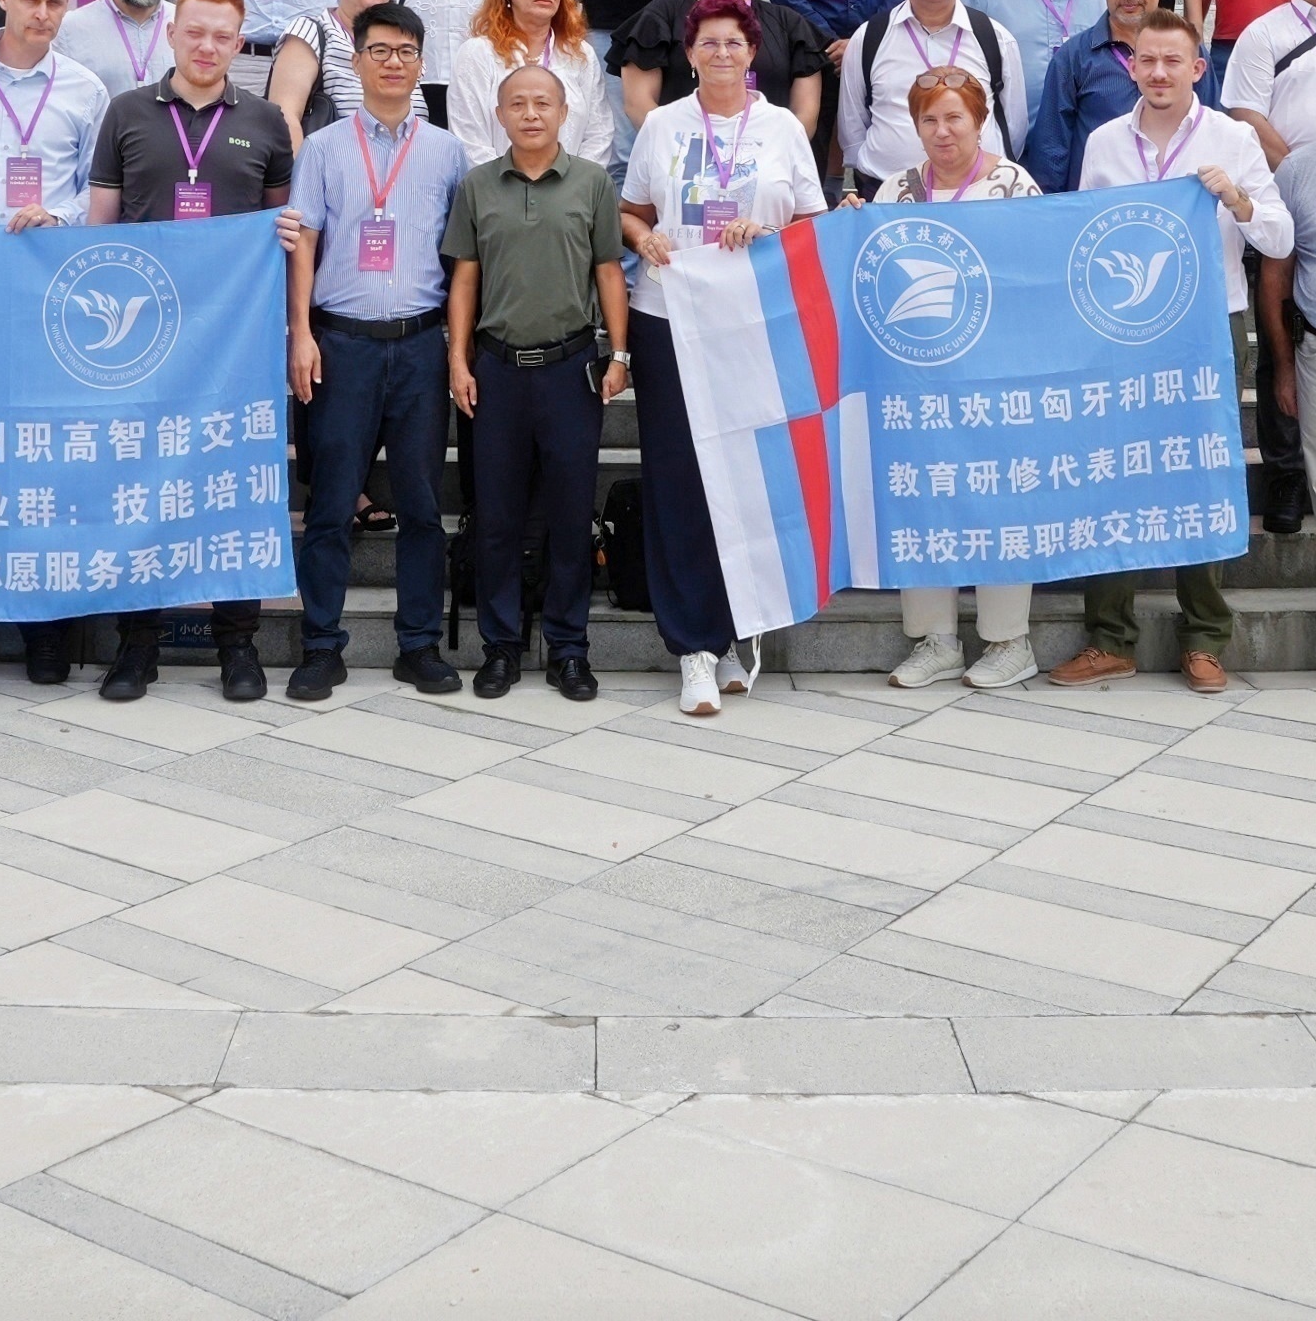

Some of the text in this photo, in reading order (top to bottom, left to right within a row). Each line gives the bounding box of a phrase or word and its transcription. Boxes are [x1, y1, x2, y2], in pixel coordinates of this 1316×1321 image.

[229, 137, 251, 148] BOSS
[863, 292, 983, 358] NINGBO POLYTECHNIC UNIVERSITY
[1077, 271, 1193, 337] NINGBO YINZHOU VOCATIONAL HIGH SCHOOL
[51, 319, 174, 381] NINGBO YINZHOU VOCATIONAL HIGH SCHOOL
[882, 366, 1221, 430] 热烈欢迎匈牙利职业
[888, 433, 1231, 497] 教育研修代表团莅临
[891, 498, 1238, 564] 我校开展职教交流活动
